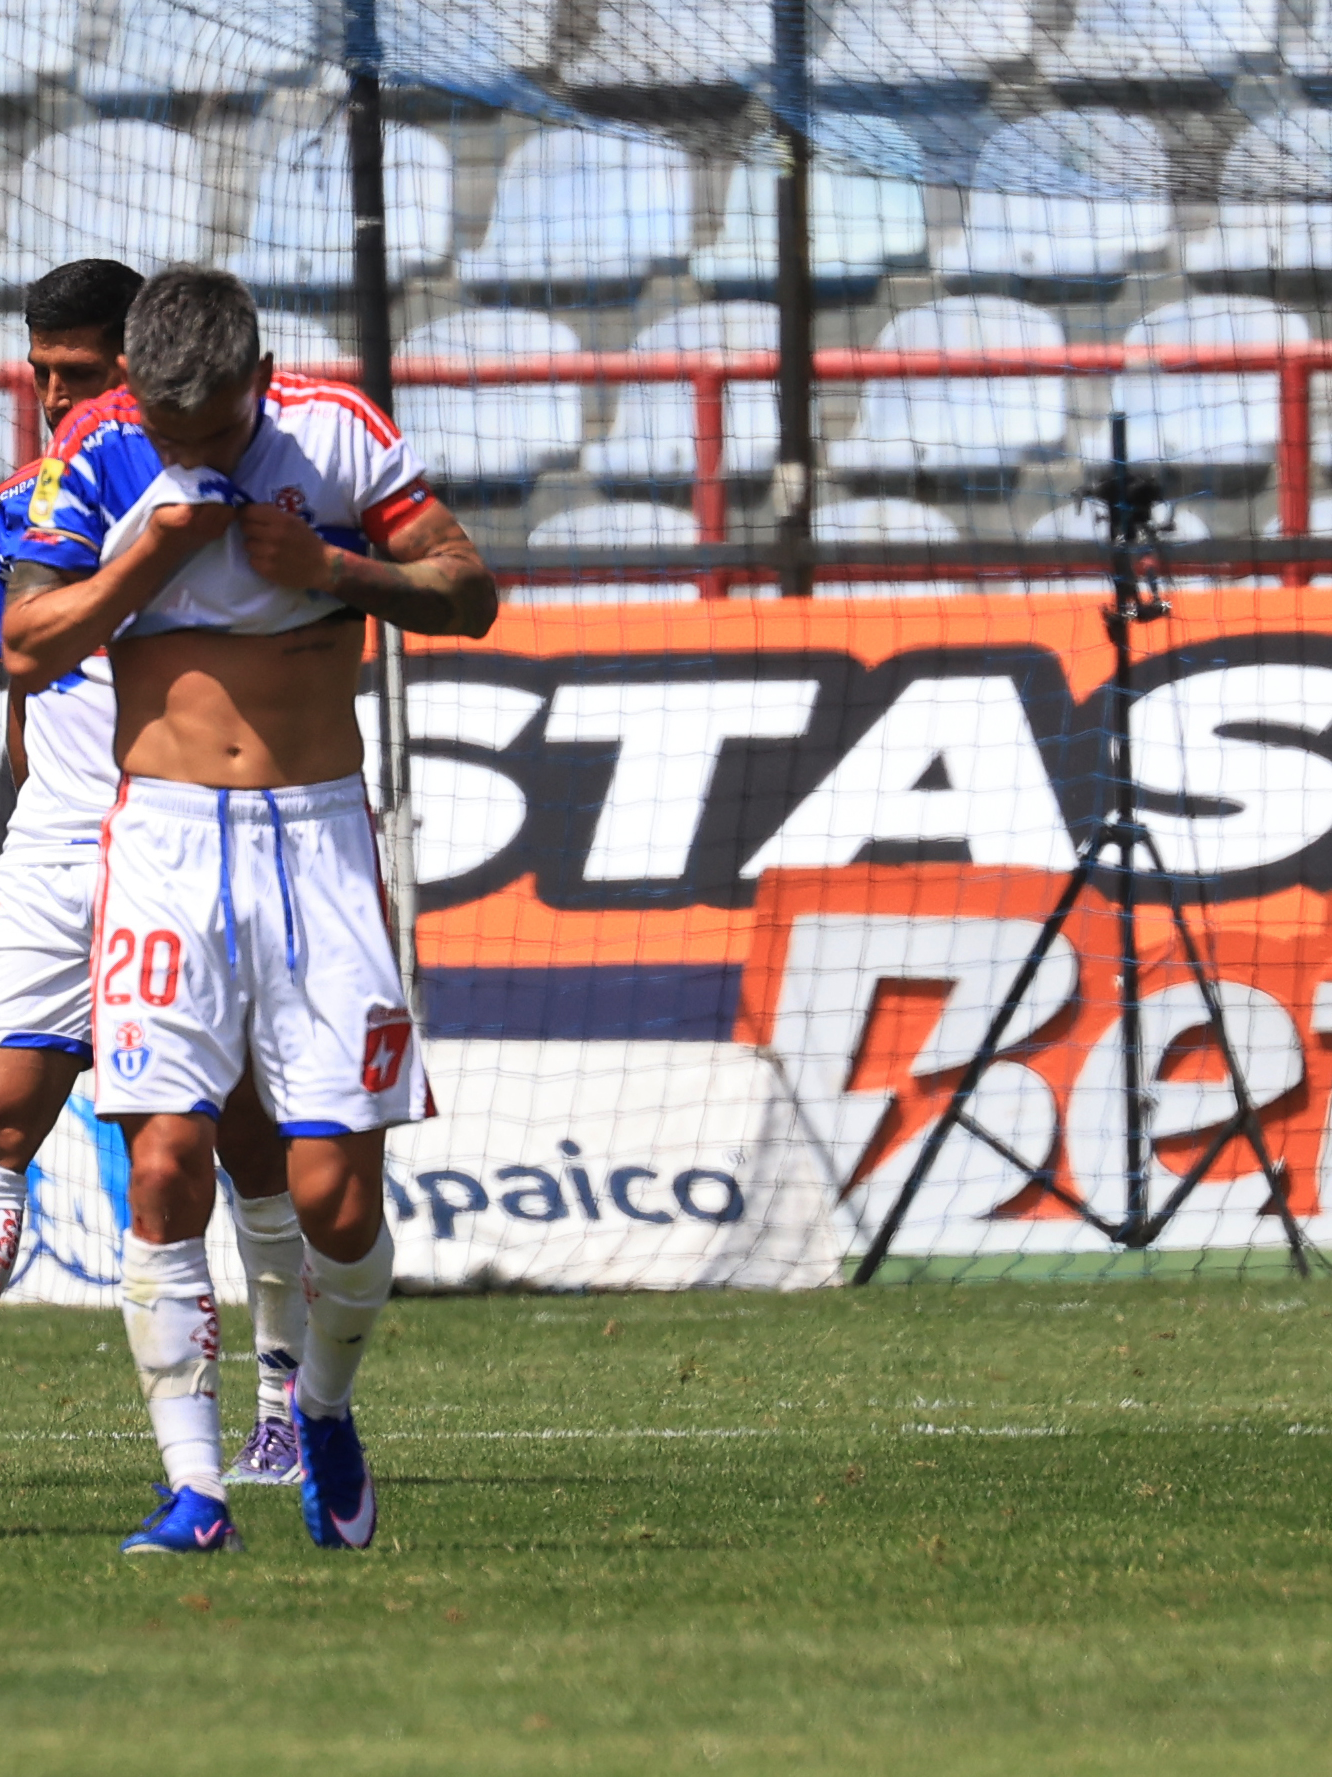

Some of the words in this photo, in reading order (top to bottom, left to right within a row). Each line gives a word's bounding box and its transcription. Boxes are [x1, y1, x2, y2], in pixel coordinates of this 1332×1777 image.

[104, 927, 181, 1008] 20
[117, 1051, 144, 1079] U
[768, 912, 1332, 1225] Be
